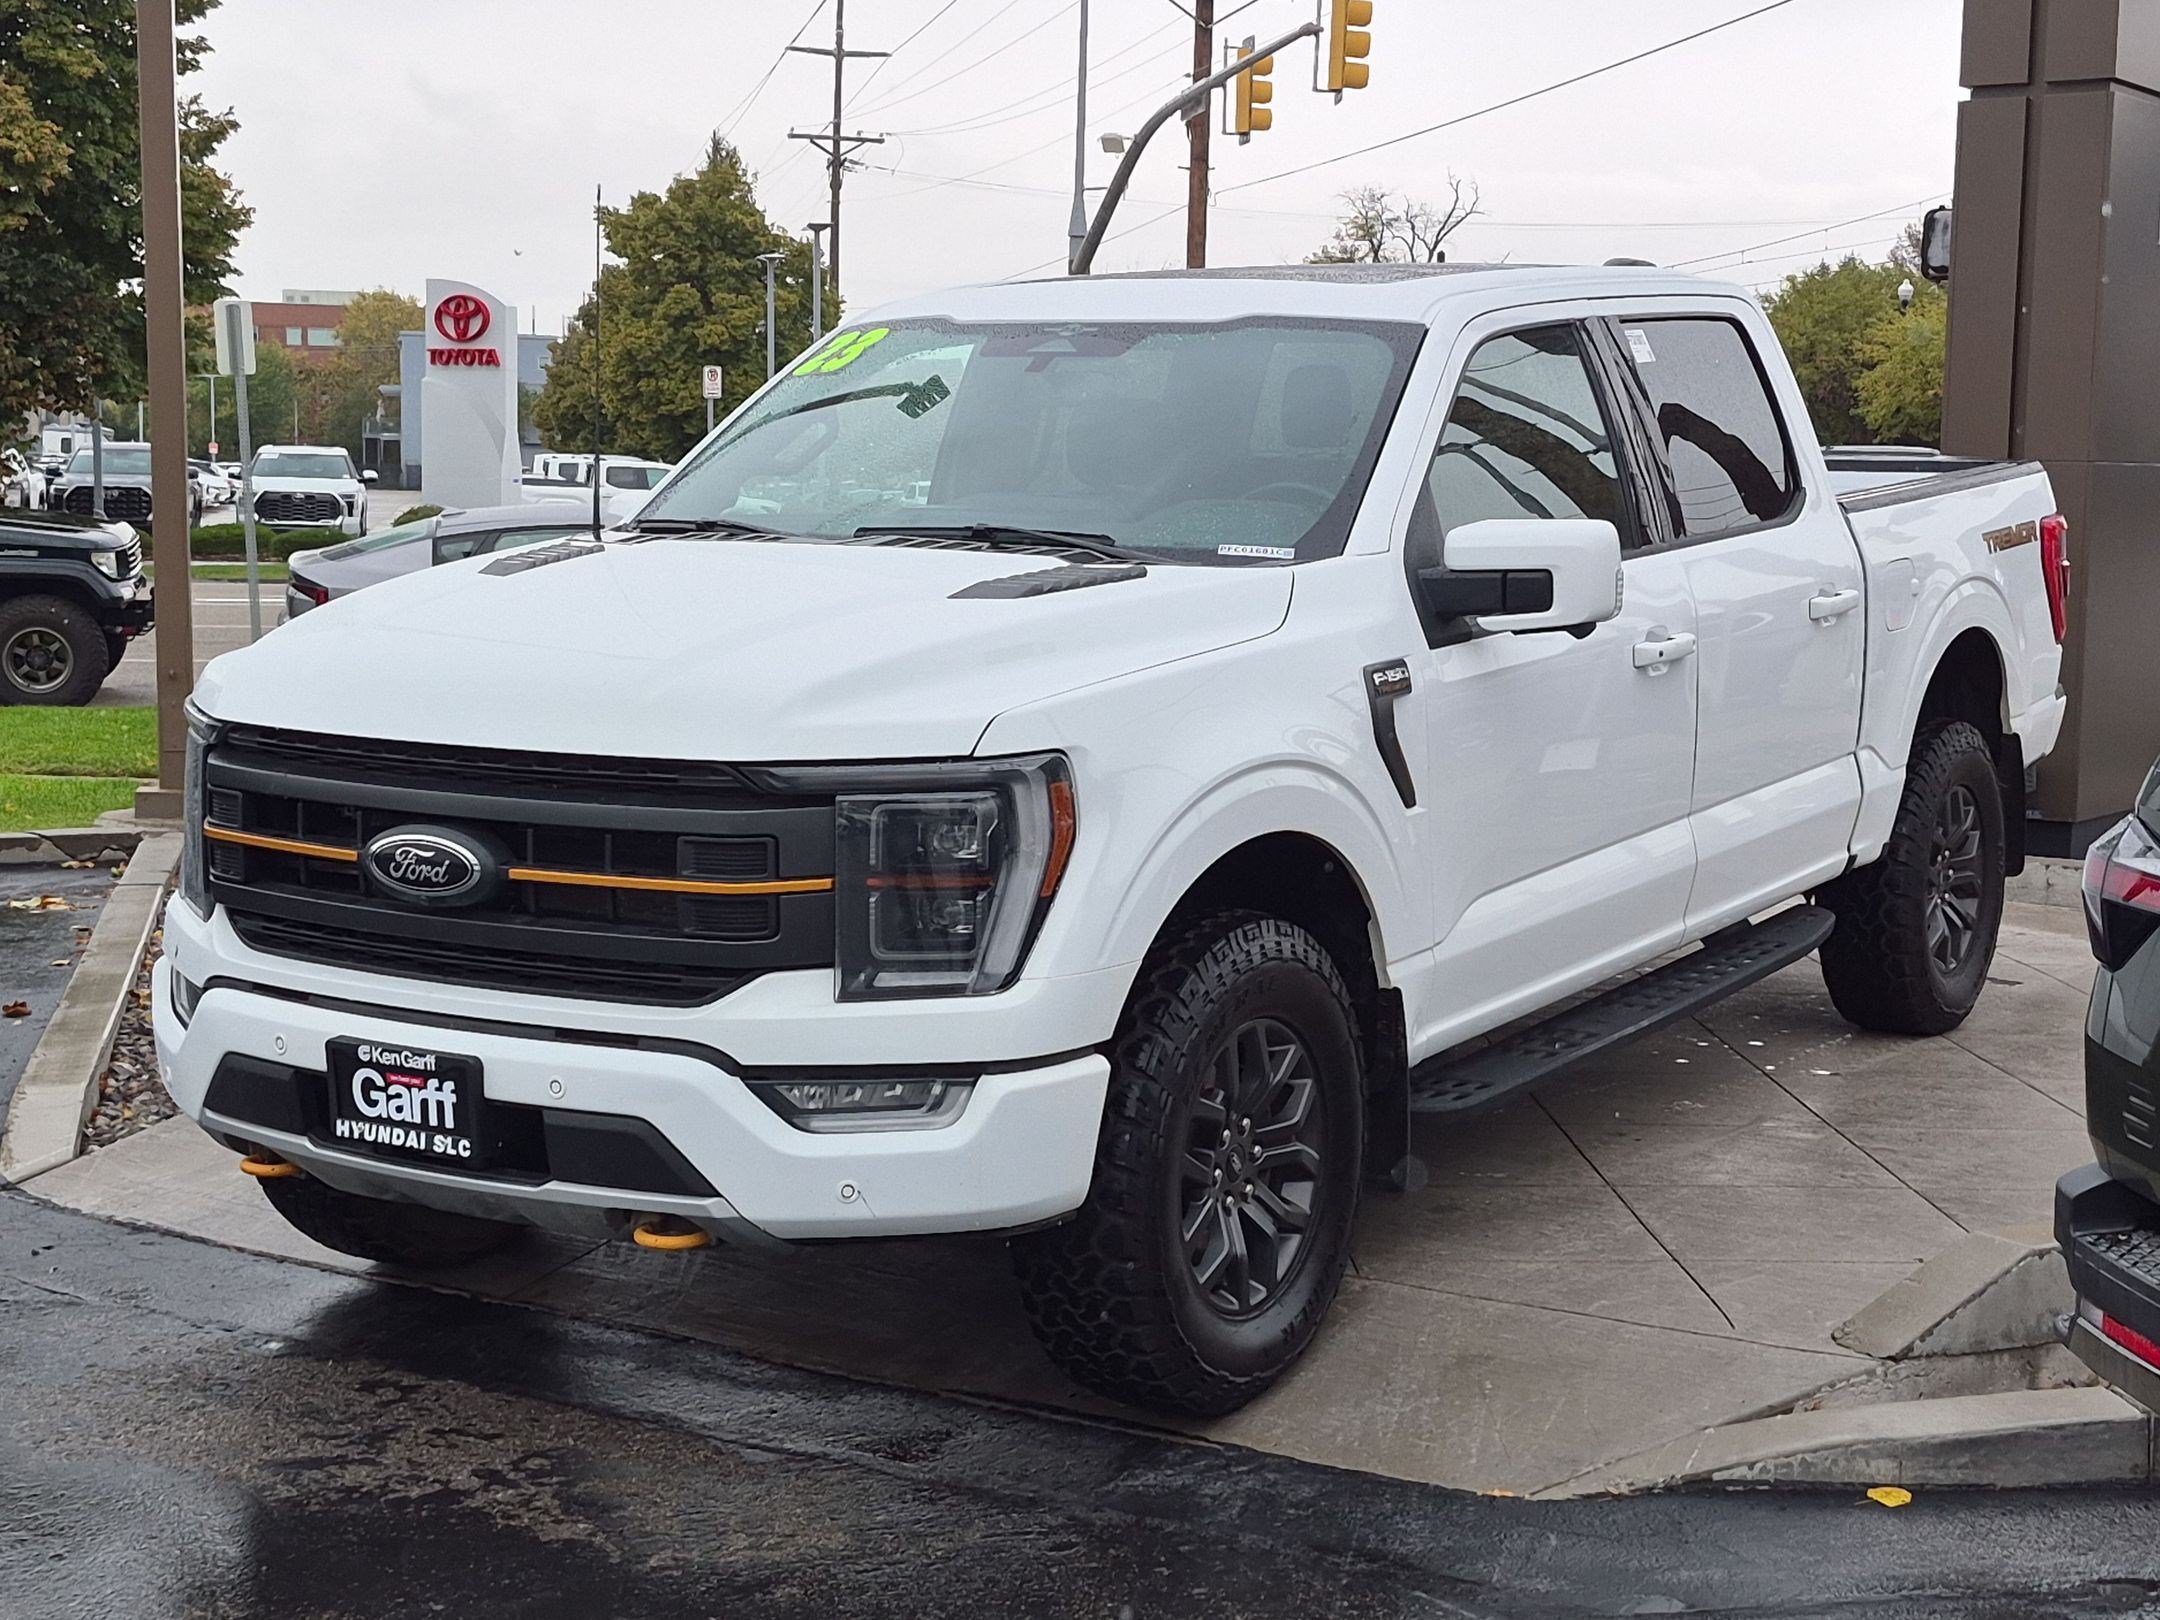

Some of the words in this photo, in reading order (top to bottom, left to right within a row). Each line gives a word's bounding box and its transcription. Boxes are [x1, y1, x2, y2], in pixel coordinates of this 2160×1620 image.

[426, 348, 501, 367] TOYOTA
[793, 328, 889, 376] 23
[1982, 520, 2038, 554] TREMOR
[1372, 667, 1409, 686] F-150
[389, 846, 451, 883] Ford
[352, 1067, 457, 1129] Garff
[336, 1118, 426, 1150] HYUNDAI
[432, 1133, 472, 1158] SLC
